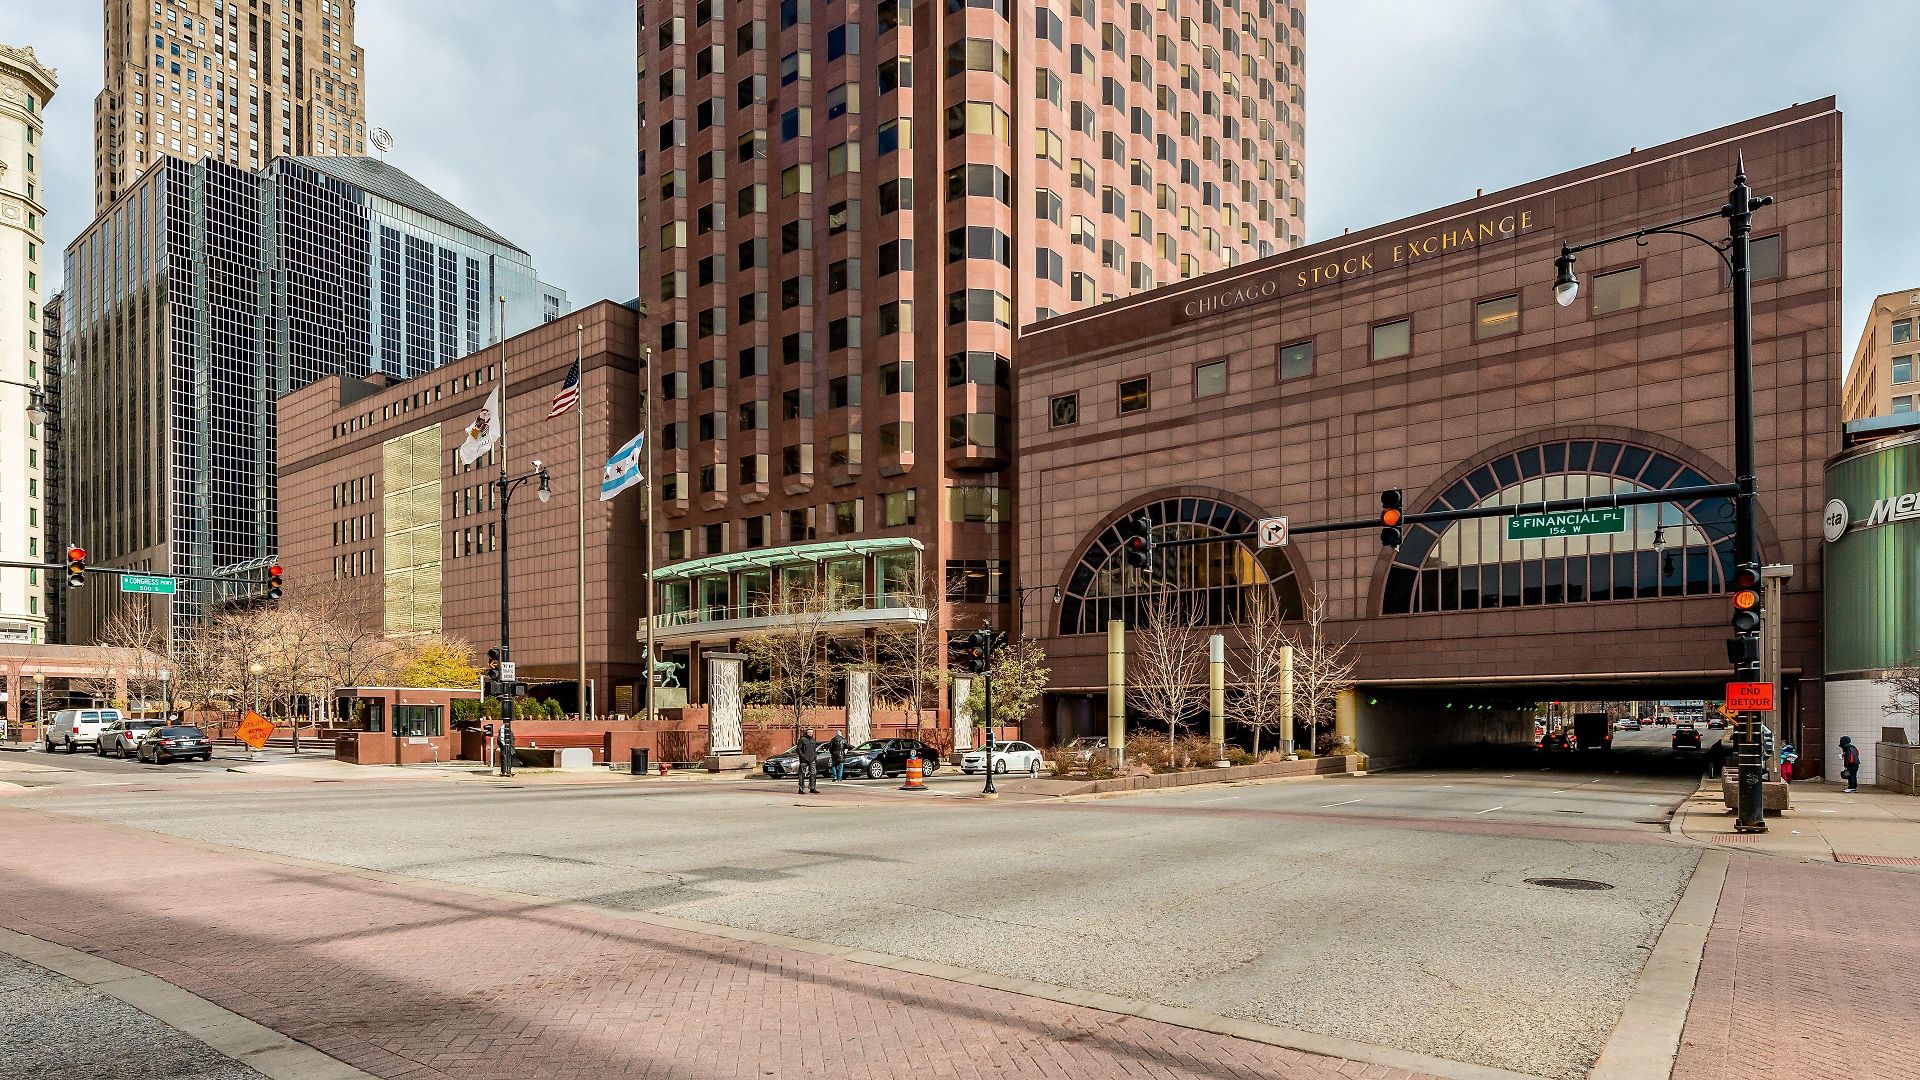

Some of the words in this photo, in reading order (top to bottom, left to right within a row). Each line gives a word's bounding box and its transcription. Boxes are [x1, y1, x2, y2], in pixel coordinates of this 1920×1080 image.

[1185, 281, 1276, 316] CHICAGO
[1297, 252, 1374, 287] STOCK
[1393, 210, 1533, 263] EXCHANGE
[1512, 520, 1520, 528] S
[1523, 513, 1600, 528] FINANCIAL
[1603, 513, 1621, 521] PL
[1826, 512, 1843, 526] cta
[1549, 527, 1567, 535] 156
[1572, 525, 1582, 533] W
[129, 577, 159, 585] CONGRESS
[1740, 687, 1761, 695] END
[1731, 698, 1770, 706] DETOUR
